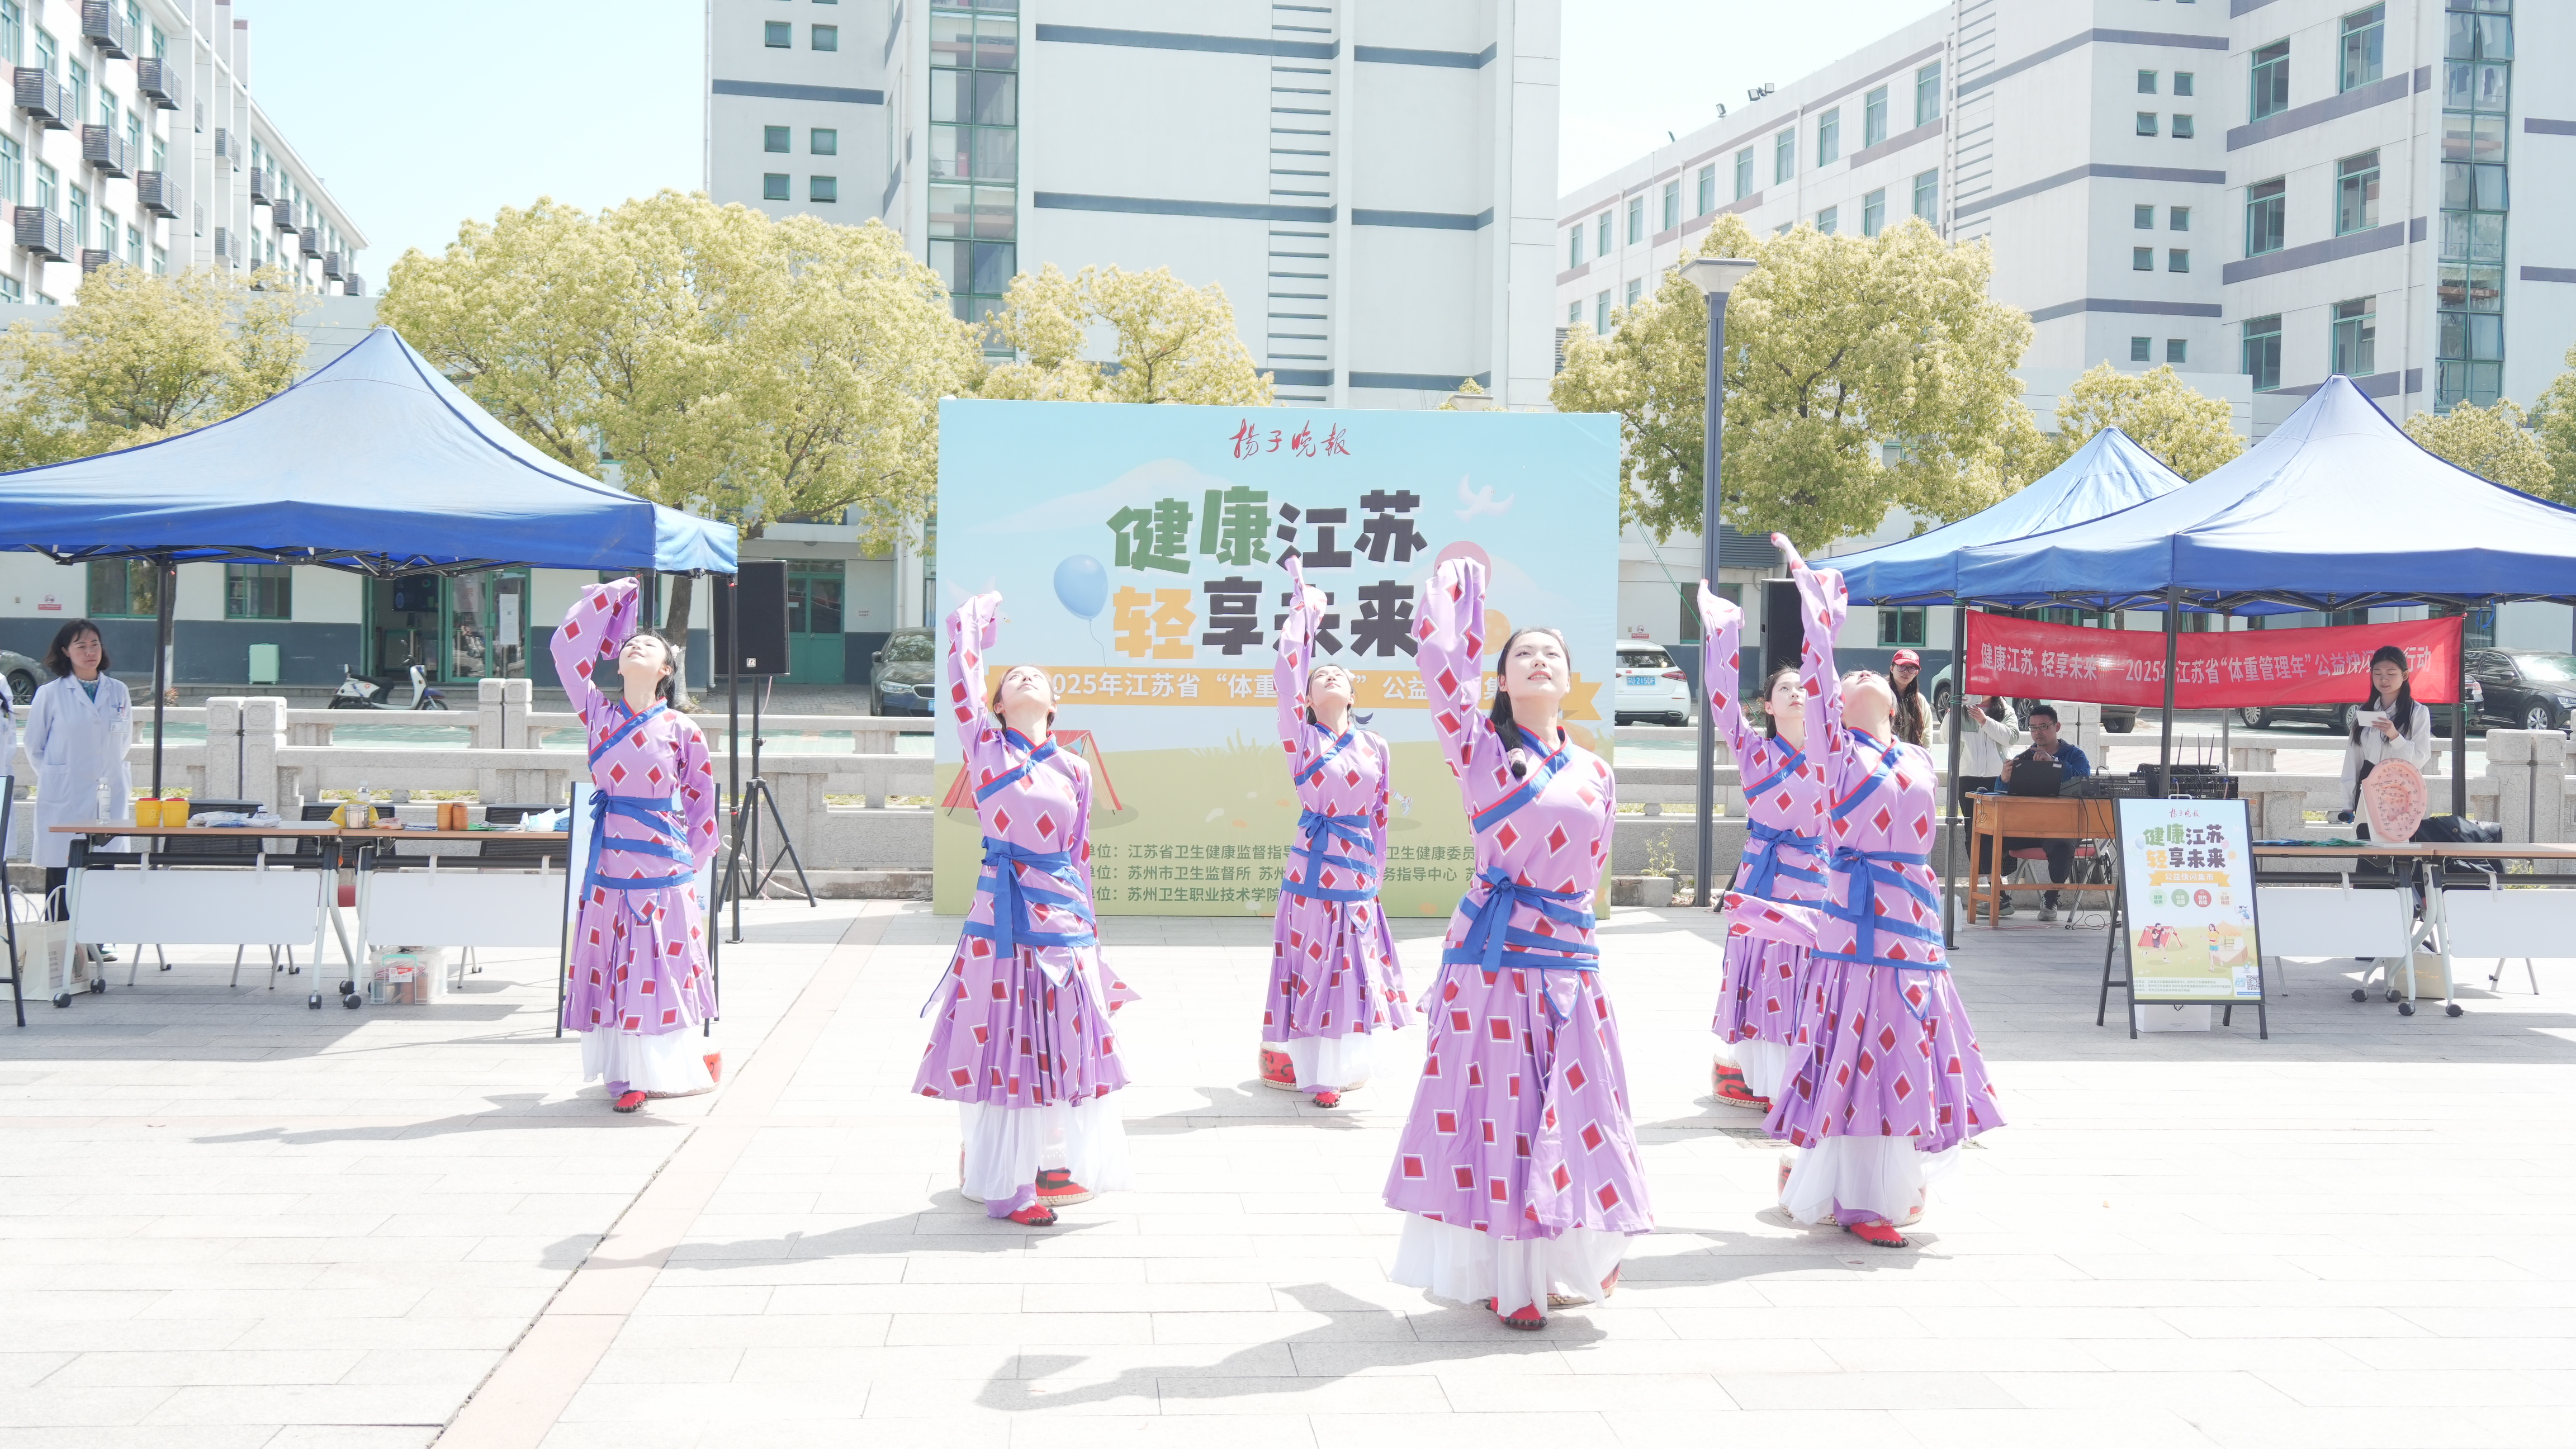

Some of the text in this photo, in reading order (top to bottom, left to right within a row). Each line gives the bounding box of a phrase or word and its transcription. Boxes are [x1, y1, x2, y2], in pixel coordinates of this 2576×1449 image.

[1105, 485, 1428, 575] 健康江苏
[2143, 823, 2225, 846] 健康江苏
[1386, 845, 1475, 861] 卫生健康委员
[2146, 846, 2226, 869] 轻享未来
[2165, 873, 2214, 881] 公益快闪集市
